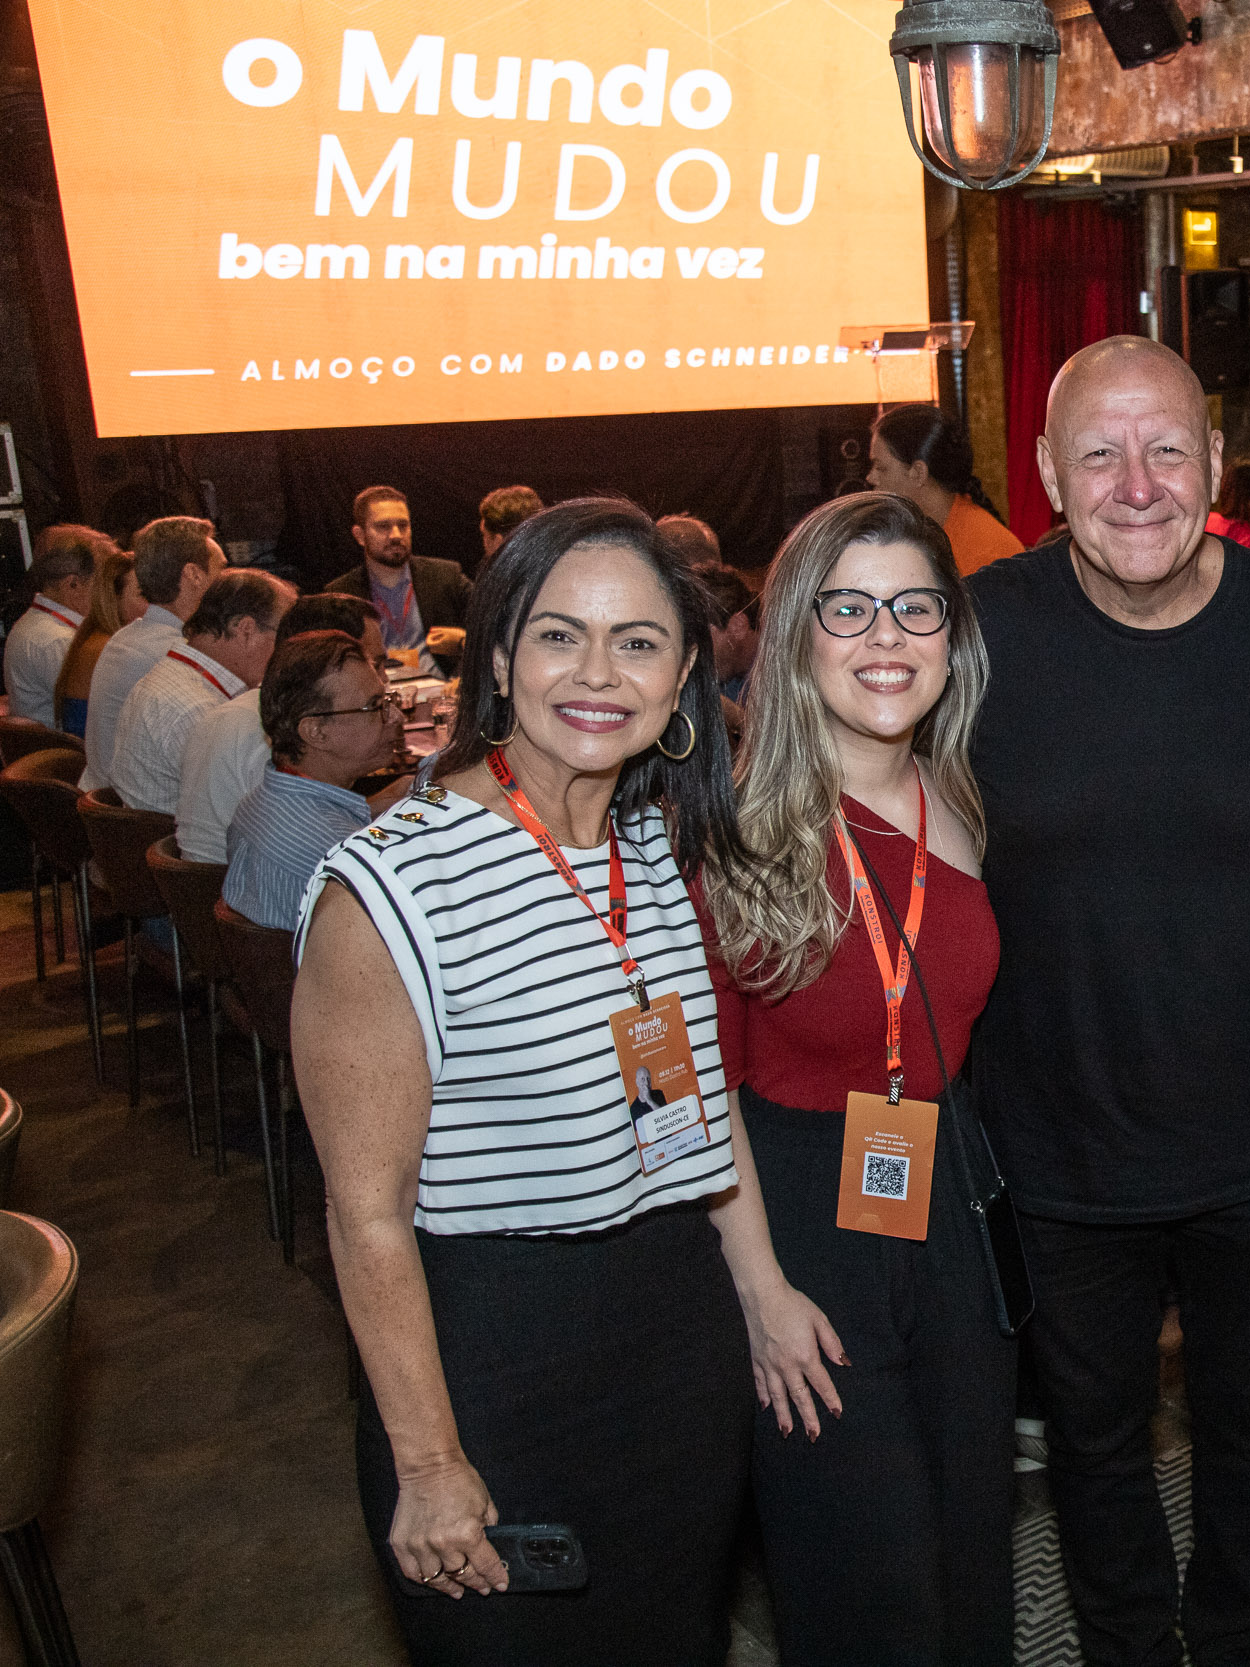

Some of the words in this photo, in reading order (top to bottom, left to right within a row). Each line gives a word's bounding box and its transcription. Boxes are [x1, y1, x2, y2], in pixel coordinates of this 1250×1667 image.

[221, 37, 304, 108] o
[336, 28, 733, 130] Mundo
[313, 133, 822, 226] MUDOU
[217, 232, 371, 280] bem
[382, 244, 466, 280] na
[476, 232, 667, 281] minha
[675, 245, 766, 281] vez
[239, 354, 417, 384] ALMOÇO
[439, 353, 525, 376] COM
[544, 349, 647, 373] DADO
[663, 344, 850, 369] SCHNEIDER
[535, 833, 573, 882] KONSTROI
[863, 893, 883, 945] KONSTROI
[899, 929, 912, 980] KONSTOI
[634, 1015, 662, 1034] Mundo
[635, 1022, 668, 1042] MUDOU
[653, 1112, 669, 1125] SILVIA
[668, 1105, 688, 1119] CASTRO
[655, 1114, 690, 1134] SINDUSCON-CE
